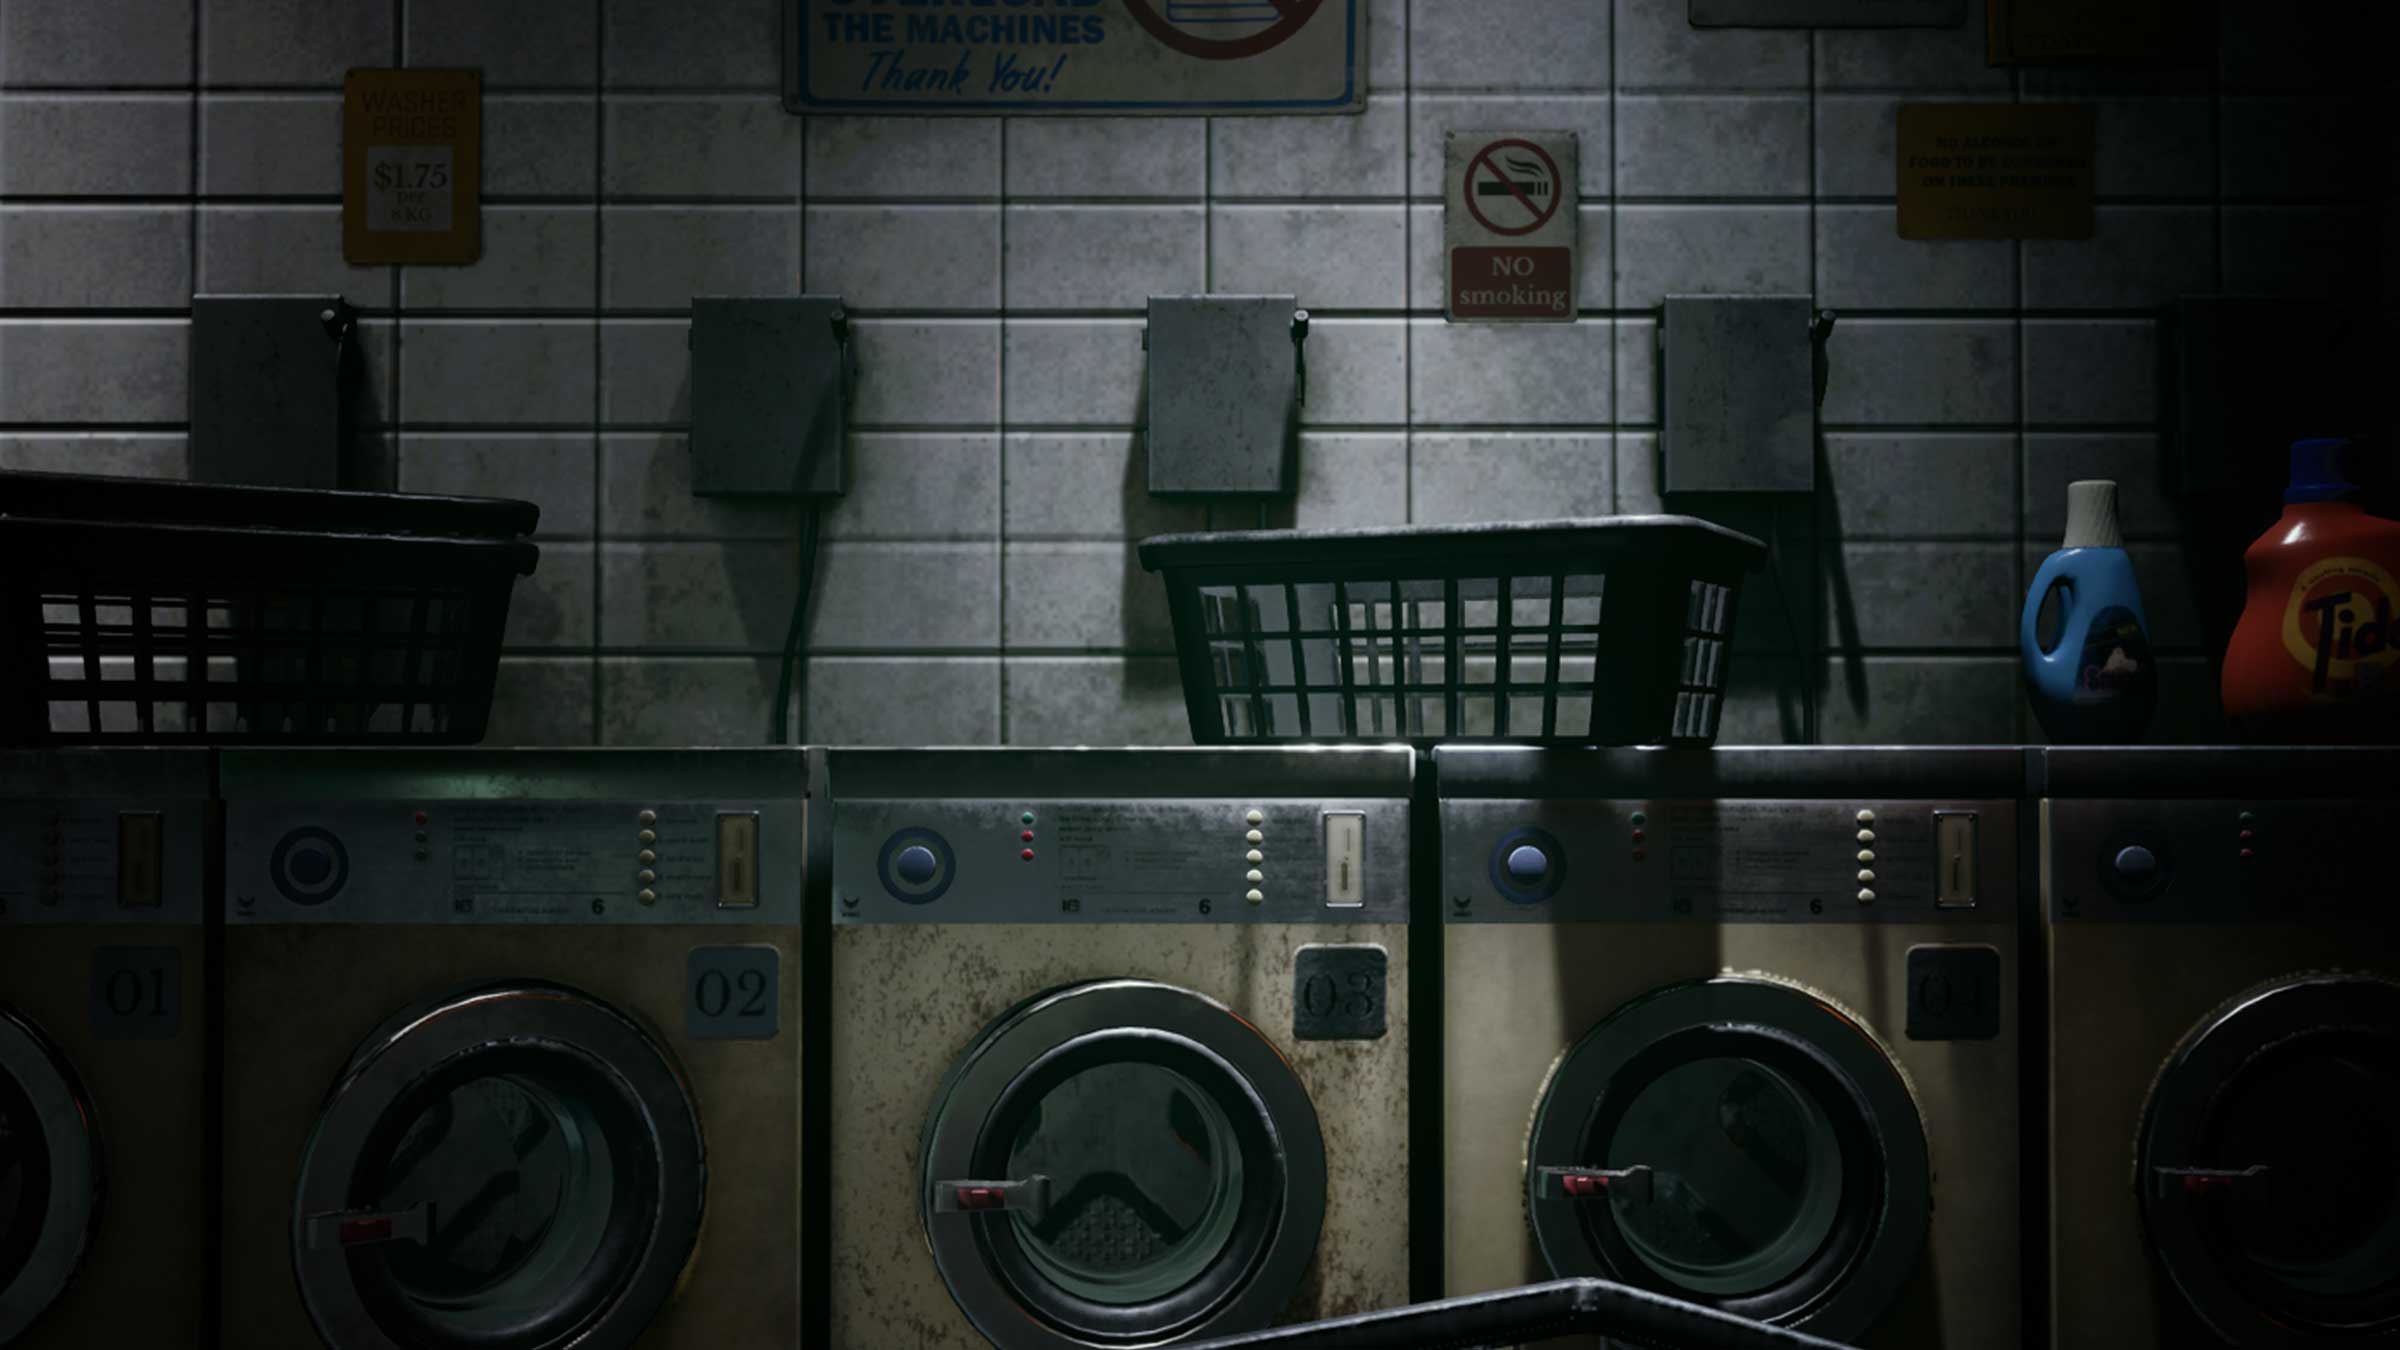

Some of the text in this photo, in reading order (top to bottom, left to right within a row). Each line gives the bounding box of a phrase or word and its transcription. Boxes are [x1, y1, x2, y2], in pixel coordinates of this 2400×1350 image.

[821, 12, 1106, 44] THE MACHINES
[860, 48, 1068, 94] Thank You!
[360, 88, 466, 112] WASHER
[372, 115, 457, 138] PRICES
[373, 160, 448, 192] $1.75
[405, 207, 433, 223] KG
[1491, 255, 1535, 277] NO
[1459, 283, 1567, 313] smoking
[105, 967, 169, 1017] 01
[695, 967, 767, 1018] 02
[1303, 971, 1373, 1019] 03
